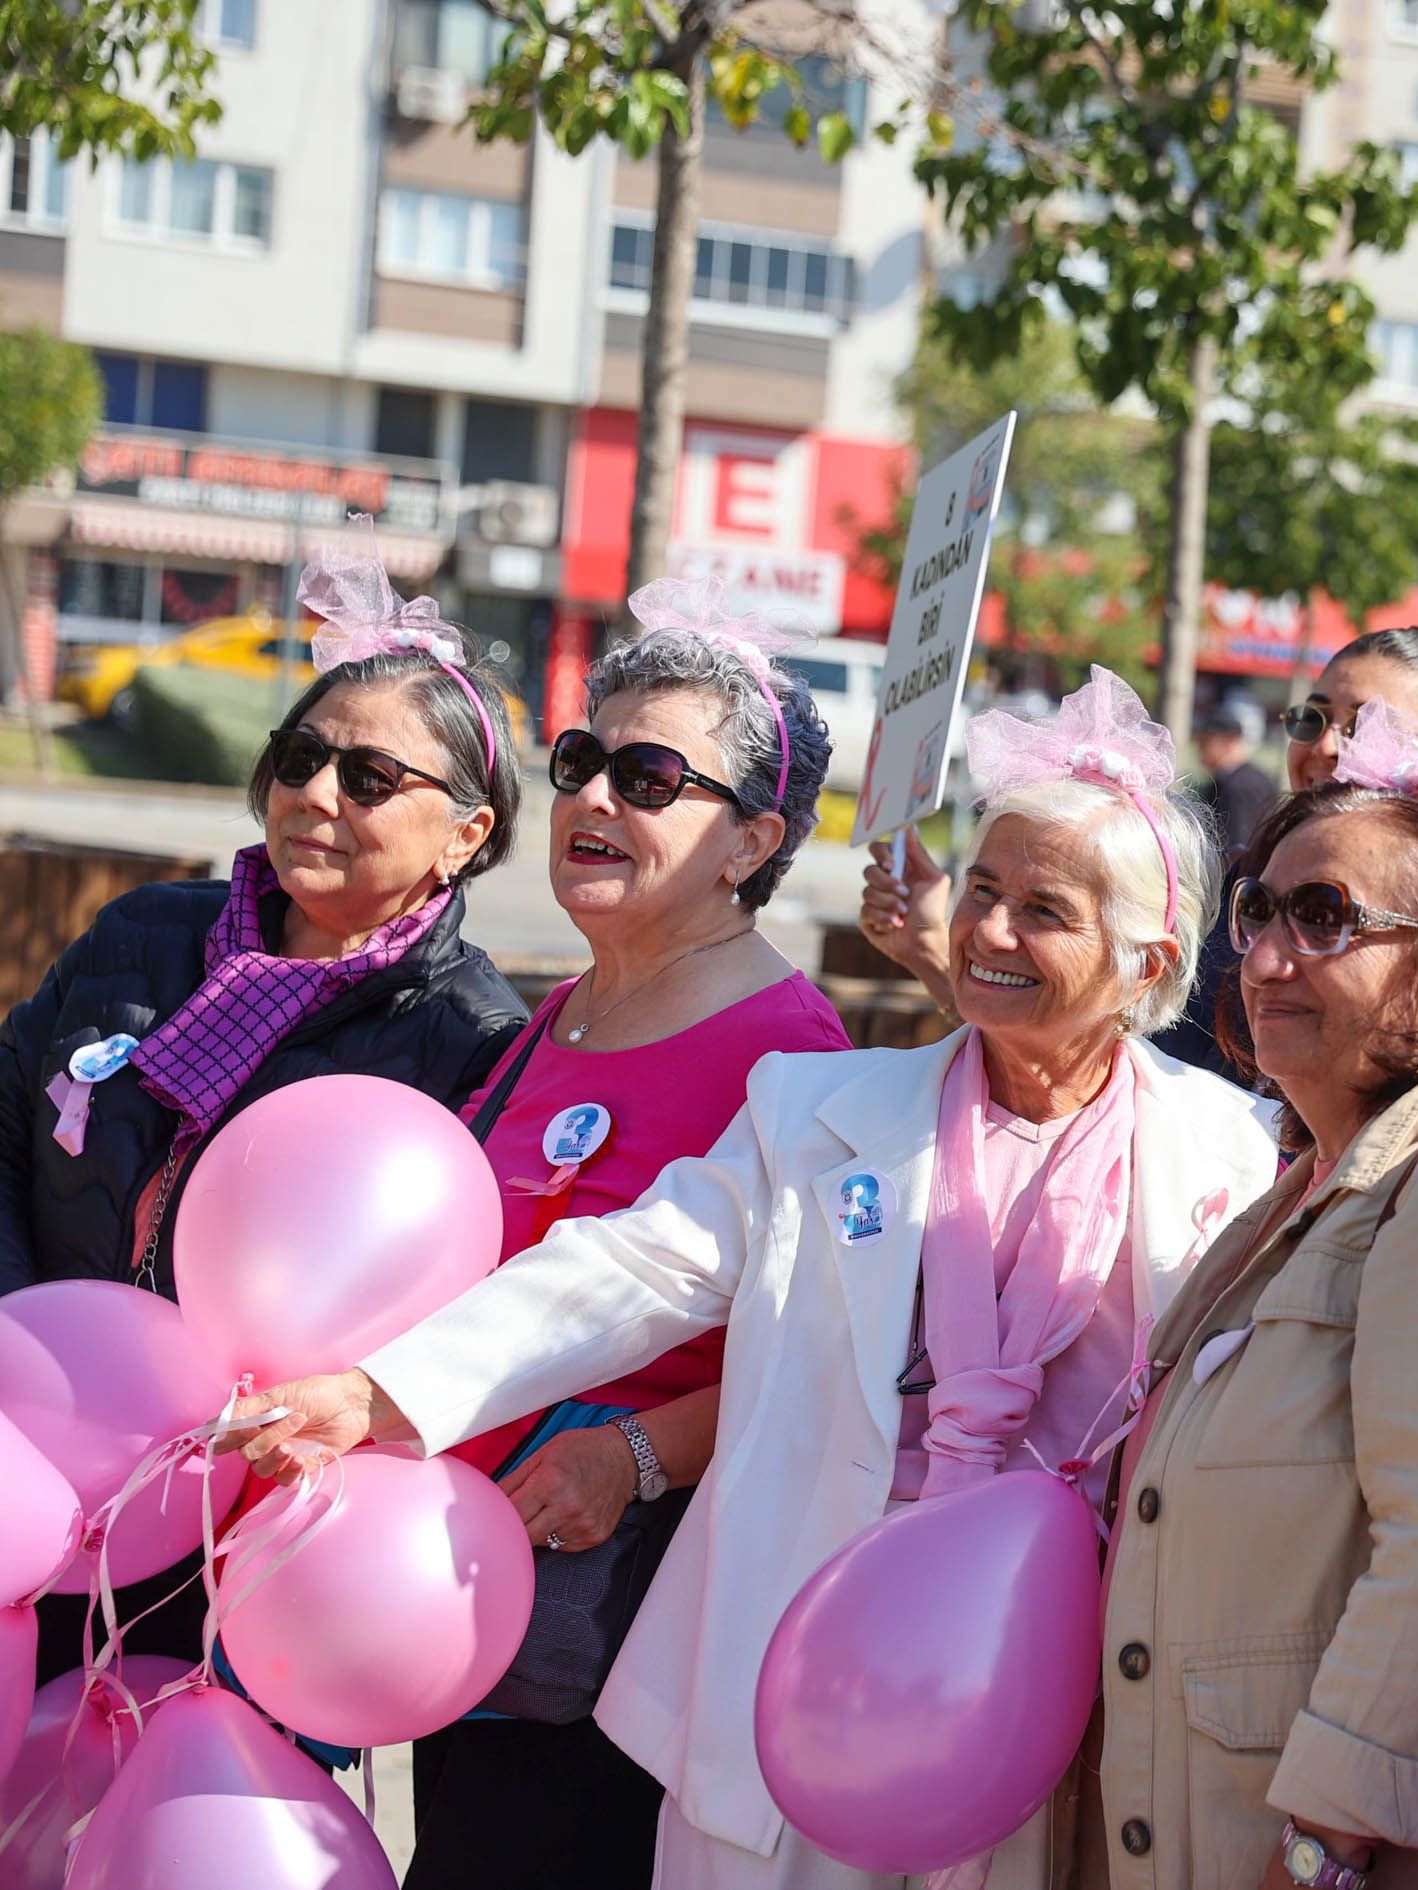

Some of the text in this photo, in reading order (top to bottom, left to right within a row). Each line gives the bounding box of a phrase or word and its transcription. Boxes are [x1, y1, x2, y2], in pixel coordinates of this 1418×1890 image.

[714, 455, 774, 535] E
[945, 490, 956, 527] 8
[911, 529, 974, 600] KADINDAN
[918, 589, 945, 646] BİRİ
[885, 640, 956, 716] OLABİLİRSİN
